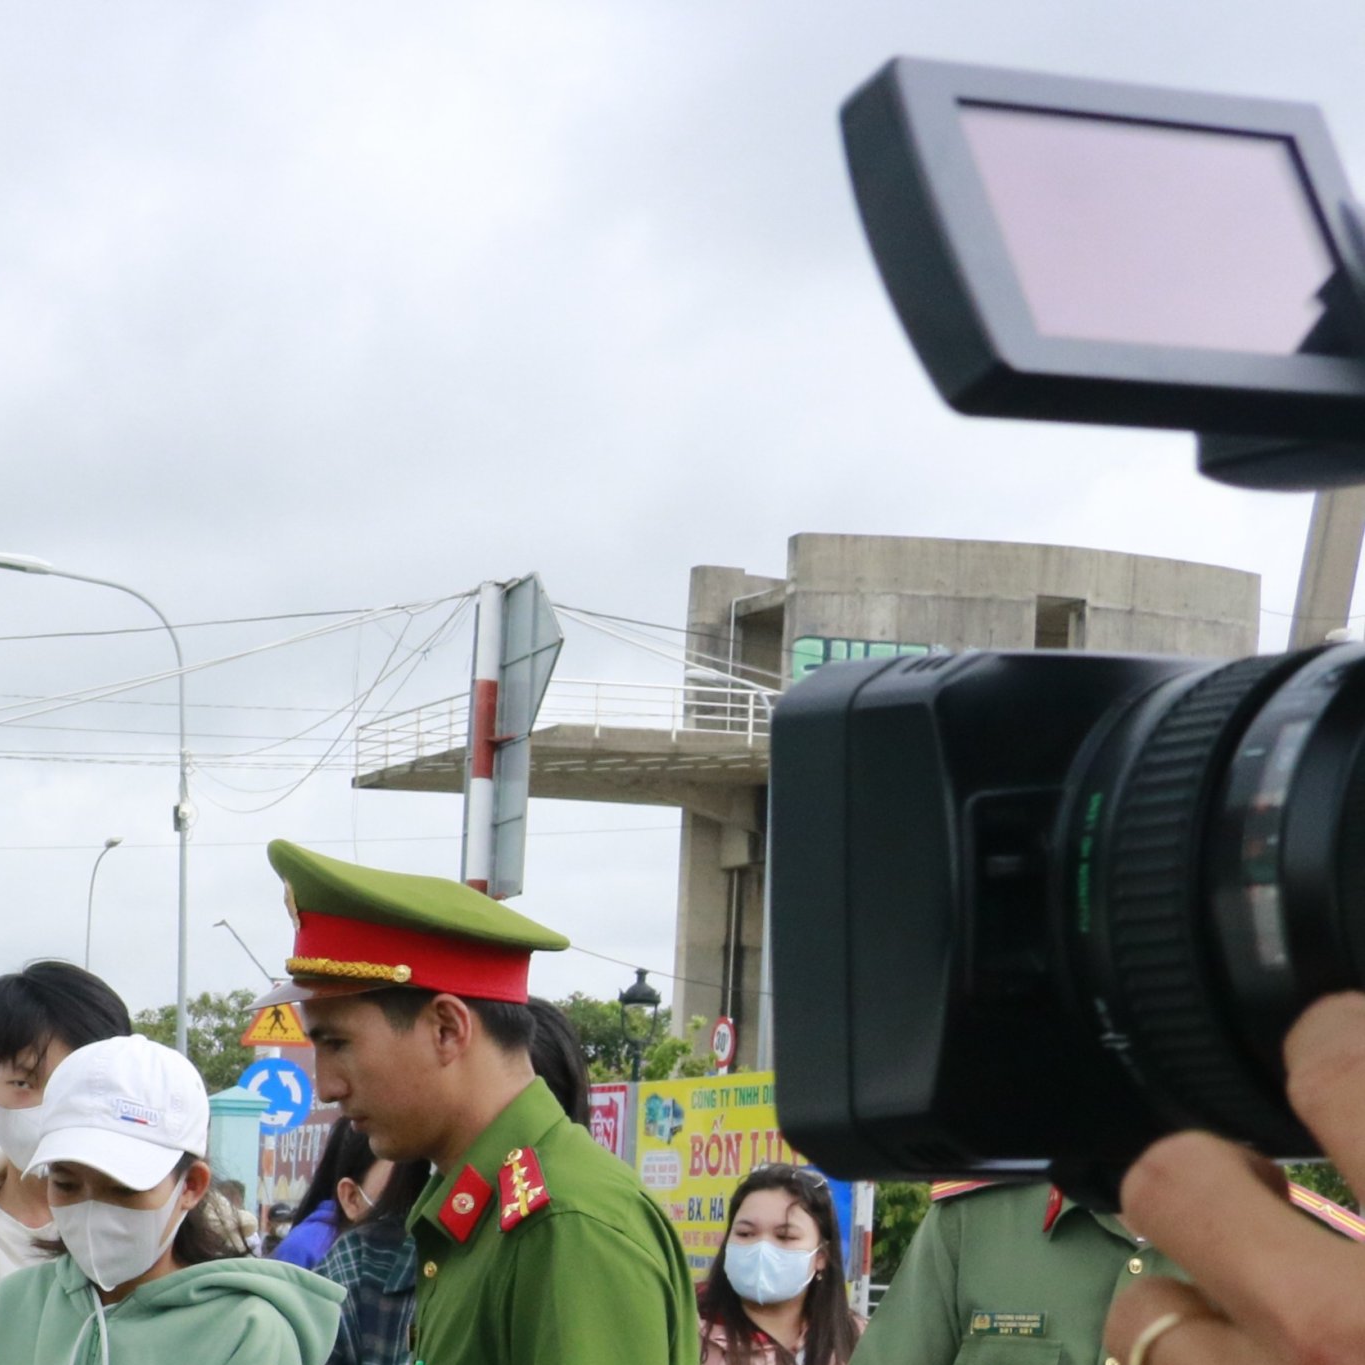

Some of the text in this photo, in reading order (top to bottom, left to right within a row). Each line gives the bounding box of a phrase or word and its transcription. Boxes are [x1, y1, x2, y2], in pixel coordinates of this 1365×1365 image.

[720, 1088, 730, 1107] TY
[734, 1086, 759, 1107] TNHH
[689, 1114, 742, 1177] BỐN
